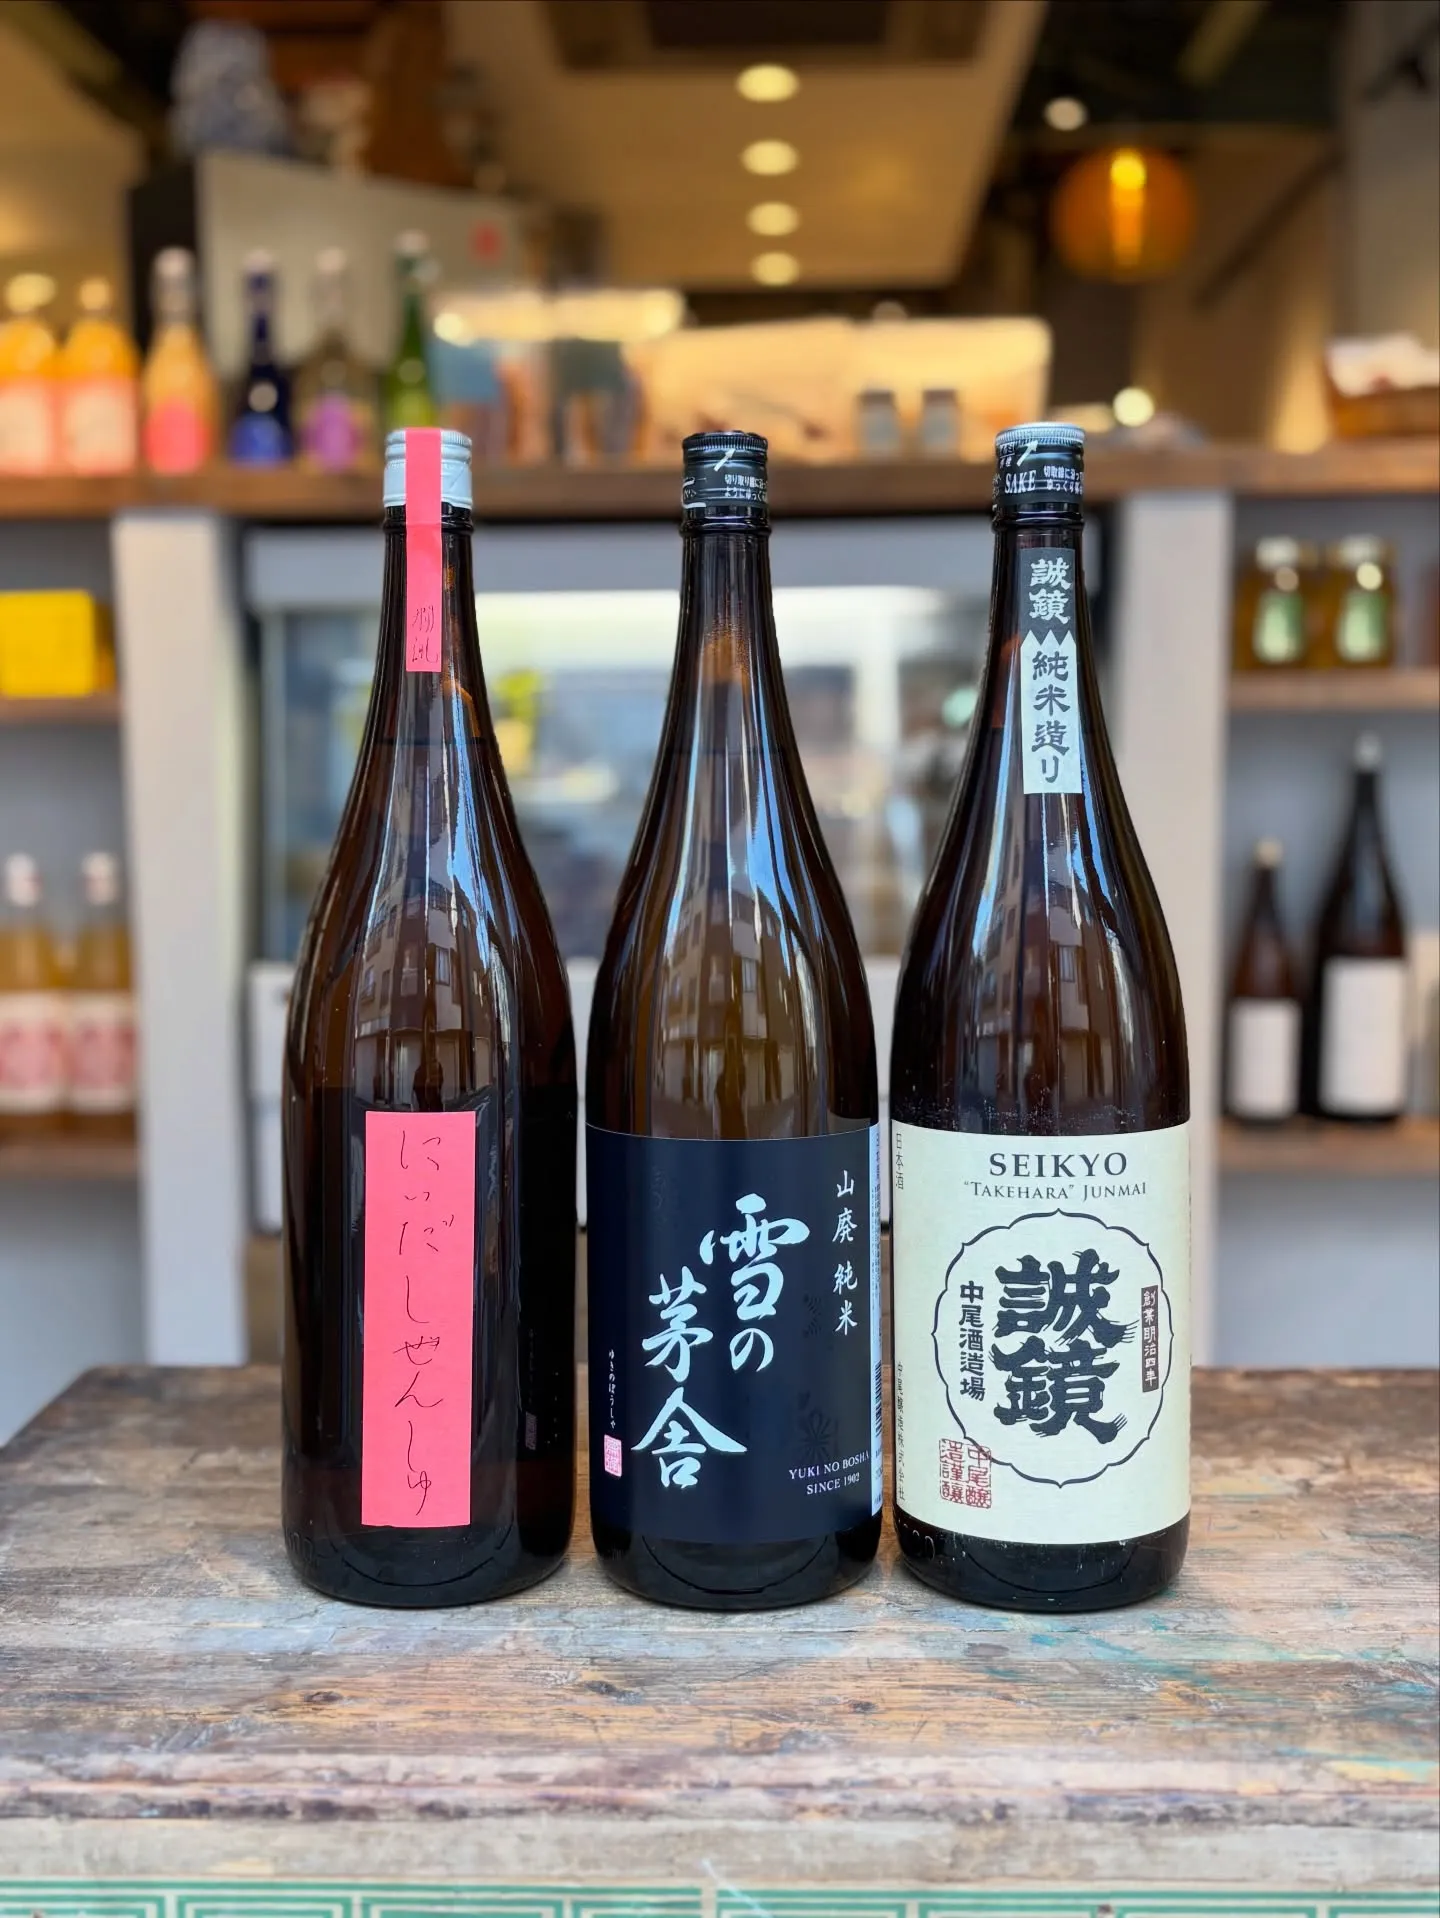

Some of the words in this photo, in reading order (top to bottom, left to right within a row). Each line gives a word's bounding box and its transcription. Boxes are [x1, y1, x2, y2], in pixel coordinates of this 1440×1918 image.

[1004, 470, 1037, 494] SAKE
[1028, 556, 1072, 624] 誠鏡
[1031, 651, 1071, 784] 純米造り
[989, 1152, 1127, 1178] SEIKYO
[1082, 1182, 1147, 1202] JUNMAI
[393, 1130, 454, 1516] にいだしぜんしゅ
[958, 1280, 986, 1402] 中尾酒造場
[988, 1248, 1140, 1446] 誠鏡
[1143, 1289, 1158, 1387] 創業明治四年
[789, 1465, 820, 1480] YUKI
[823, 1461, 840, 1475] NO
[842, 1450, 869, 1470] BOSHA
[806, 1478, 840, 1495] SINCE
